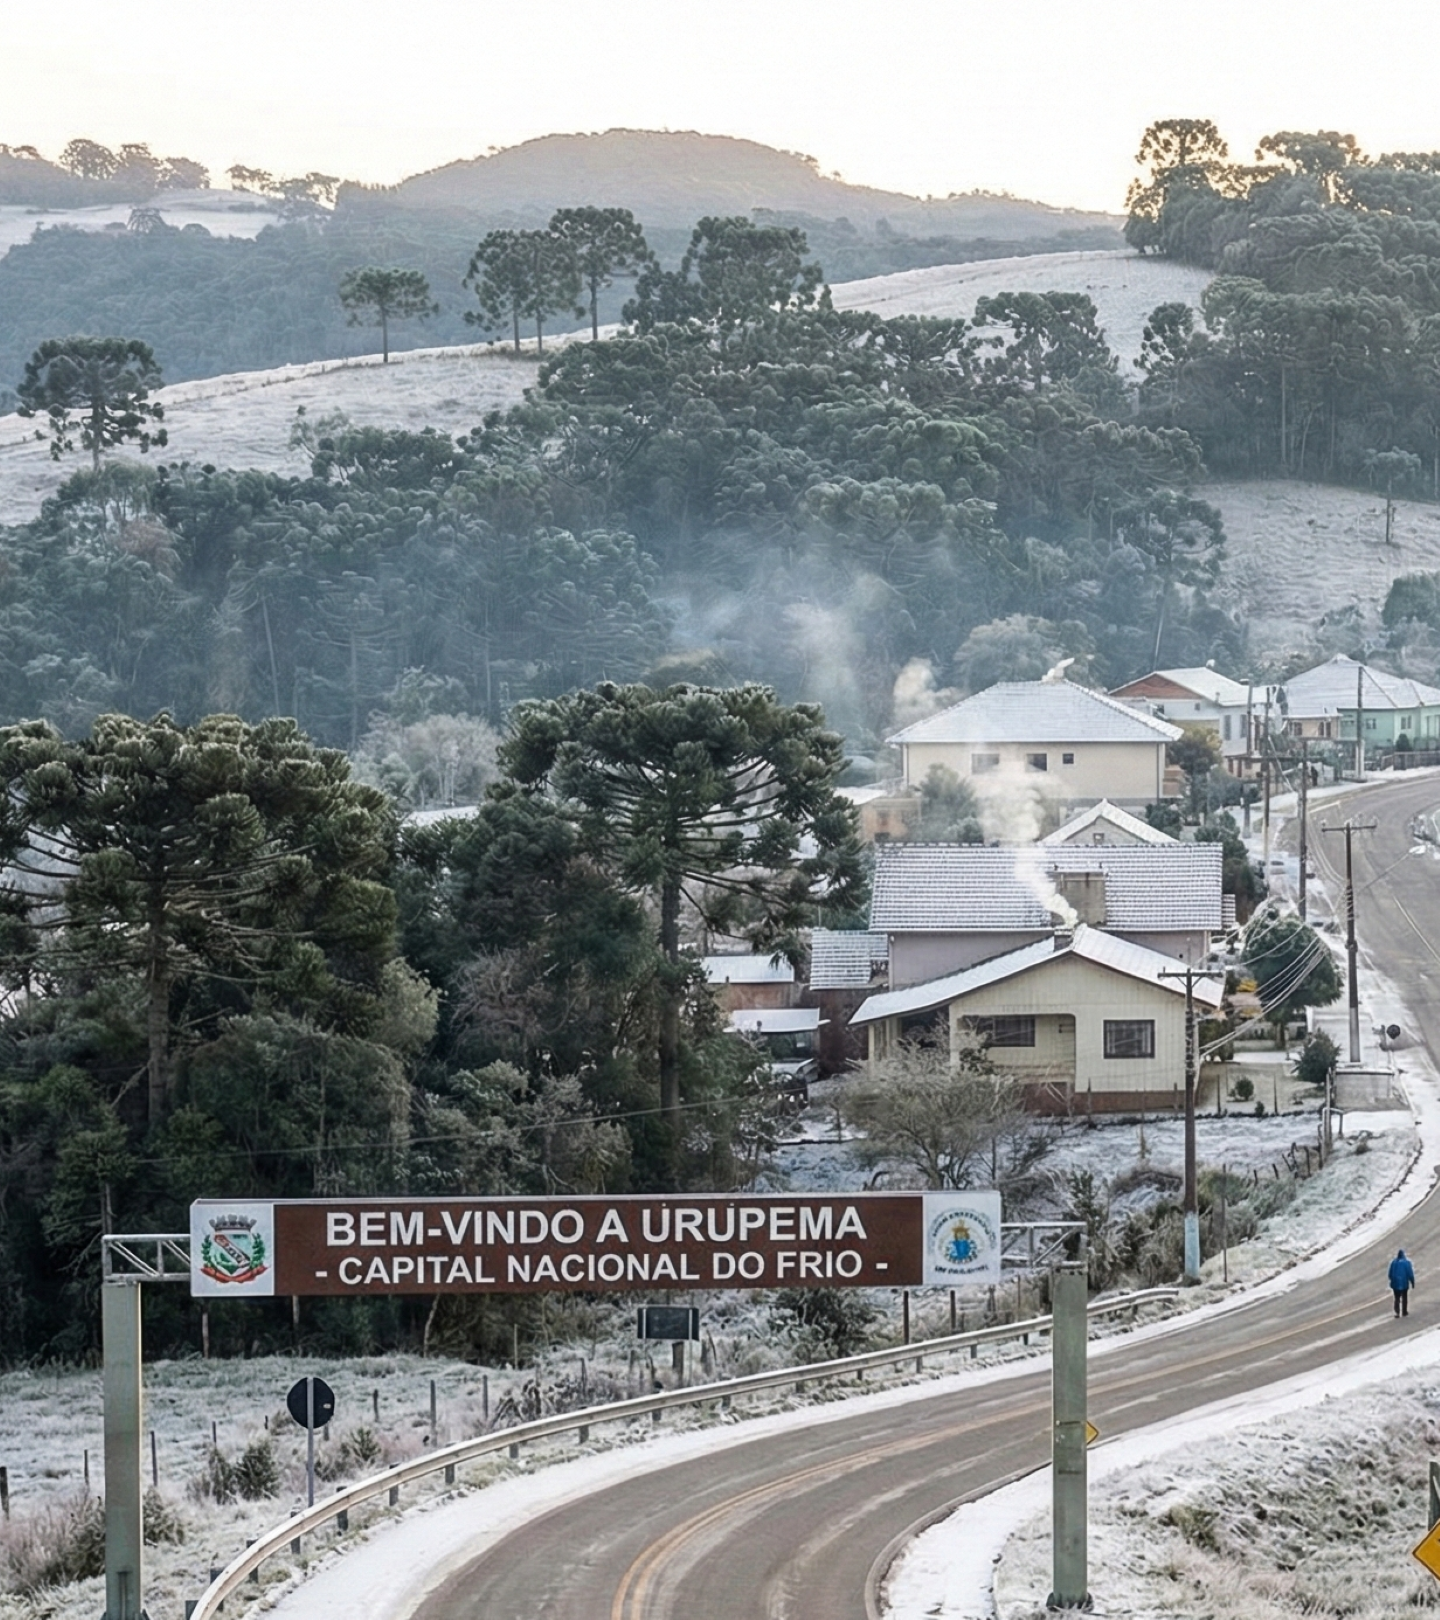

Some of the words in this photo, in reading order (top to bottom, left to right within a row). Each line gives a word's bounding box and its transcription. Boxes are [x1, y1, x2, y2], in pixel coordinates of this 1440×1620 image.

[326, 1209, 584, 1246] BEM-VINDO
[596, 1209, 628, 1242] A
[339, 1256, 495, 1285] CAPITAL
[507, 1253, 700, 1282] NACIONAL
[713, 1251, 764, 1280] DO
[777, 1250, 862, 1278] FRIO
